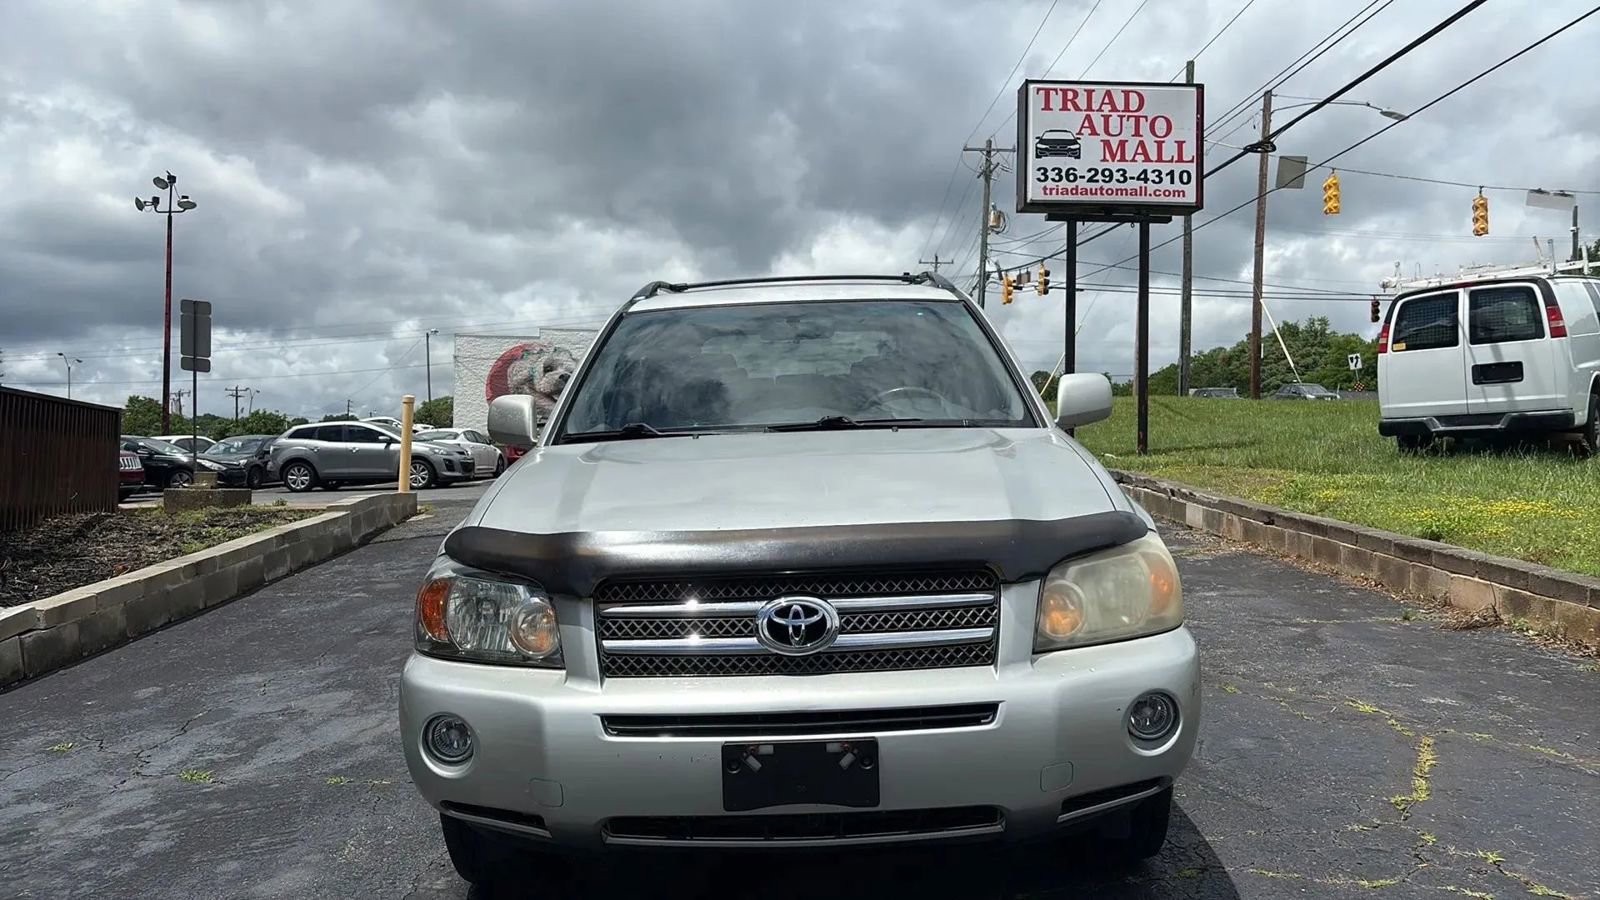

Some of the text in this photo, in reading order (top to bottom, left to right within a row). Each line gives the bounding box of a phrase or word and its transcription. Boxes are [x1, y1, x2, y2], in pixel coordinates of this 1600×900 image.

[1036, 87, 1145, 113] TRIAD
[1076, 114, 1173, 138] AUTO
[1100, 139, 1195, 164] MALL
[1036, 167, 1192, 185] 336-293-4310
[1042, 185, 1186, 198] triadautomall.com
